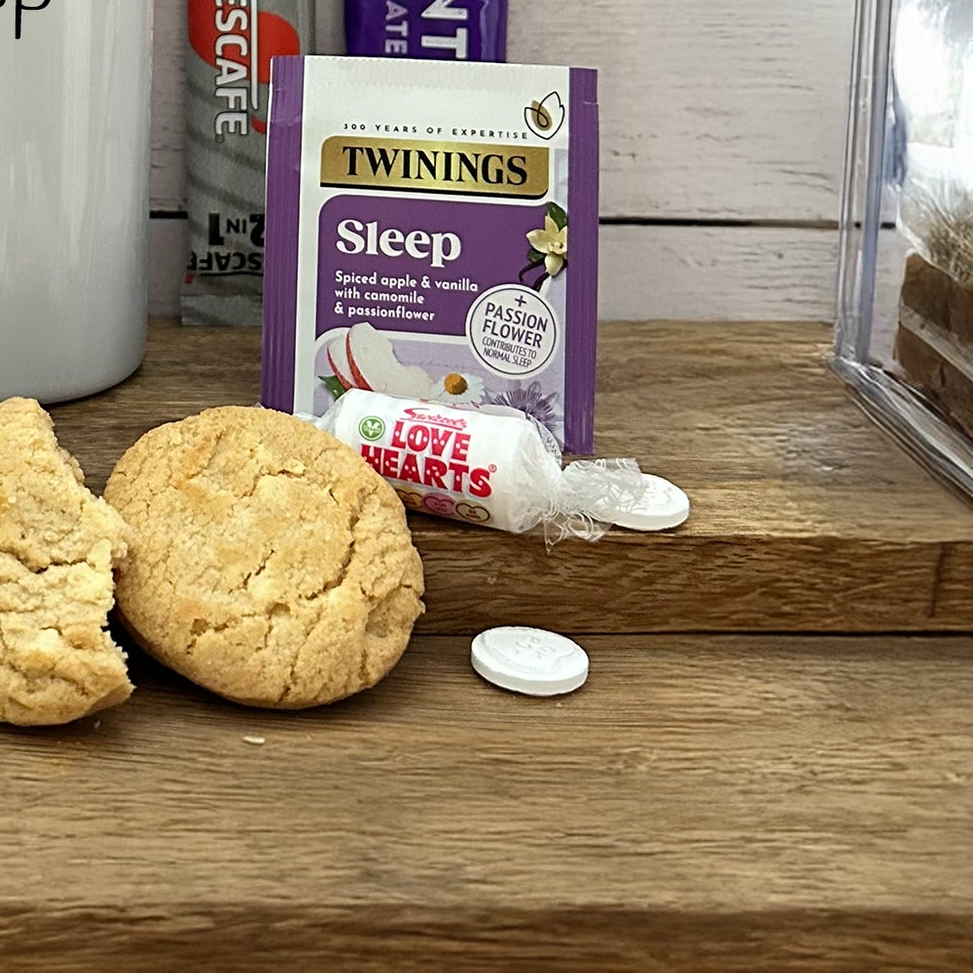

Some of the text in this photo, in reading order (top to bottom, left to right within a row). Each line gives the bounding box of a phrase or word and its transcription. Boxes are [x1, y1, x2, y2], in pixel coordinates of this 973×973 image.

[343, 123, 528, 140] 300 YEARS OF EXPERTISE
[342, 146, 528, 186] TWININGS
[336, 219, 462, 268] Sleep
[335, 270, 478, 292] Spiced apple & vanilla
[334, 286, 425, 304] with camomile
[334, 301, 435, 321] & passionflower
[484, 301, 548, 333] PASSION
[482, 318, 543, 349] FLOWER
[482, 336, 537, 360] CONTRIBUTES TO
[482, 347, 532, 368] NORMAL SLEEP
[391, 420, 472, 462] LOVE
[361, 443, 493, 498] HEARTS
